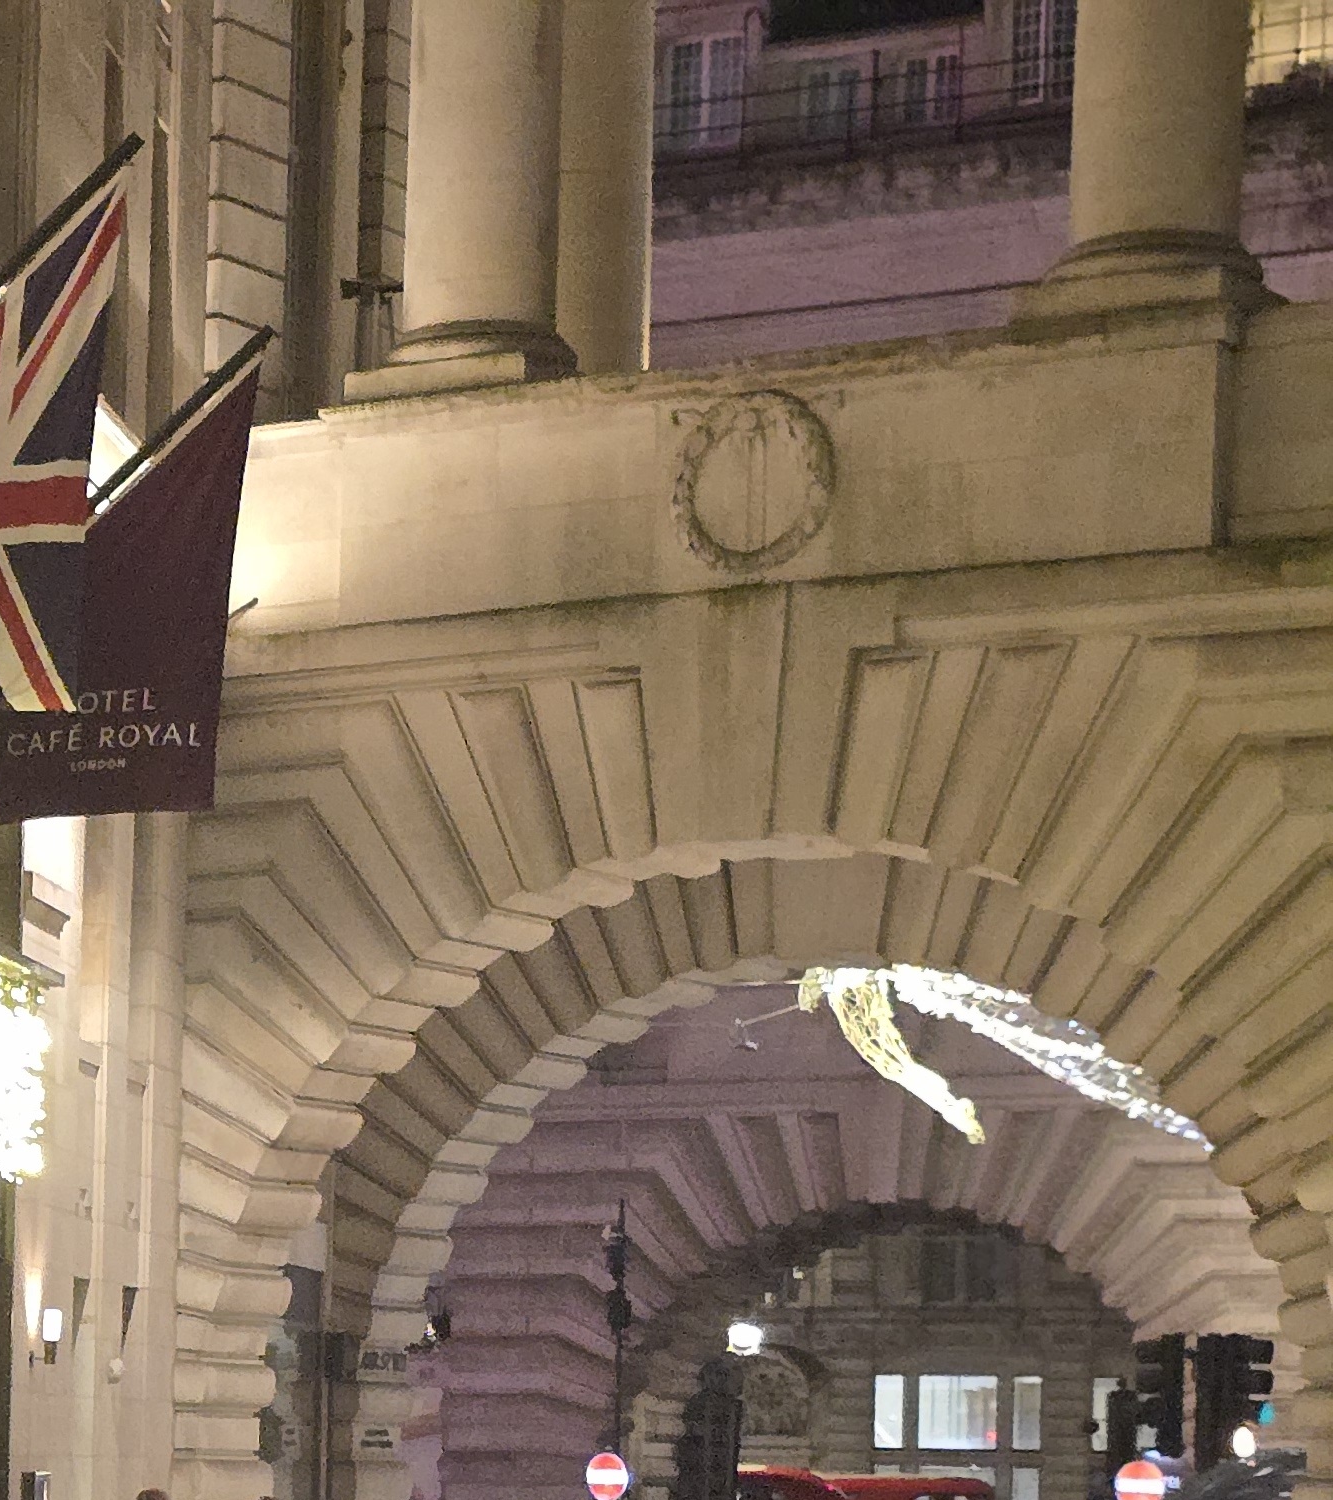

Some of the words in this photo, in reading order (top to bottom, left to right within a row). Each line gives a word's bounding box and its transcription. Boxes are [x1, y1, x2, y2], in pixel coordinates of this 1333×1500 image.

[77, 687, 156, 715] OTEL
[6, 722, 83, 757] CAFÉ
[98, 721, 202, 750] ROYAL
[70, 757, 127, 773] LONDON
